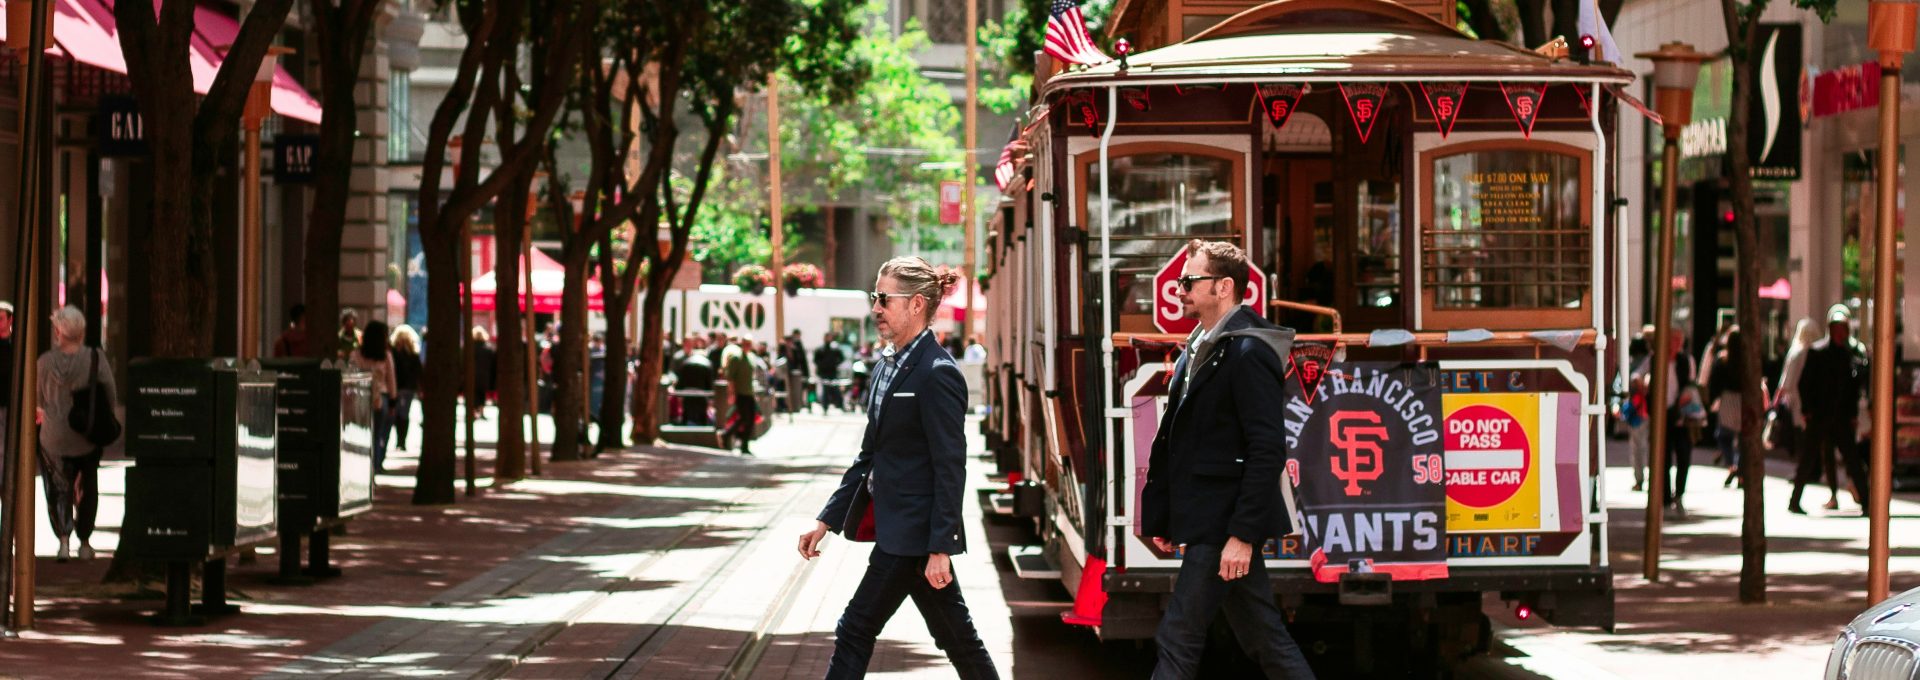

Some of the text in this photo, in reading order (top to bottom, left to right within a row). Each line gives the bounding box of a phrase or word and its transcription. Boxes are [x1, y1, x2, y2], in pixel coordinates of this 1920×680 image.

[286, 145, 312, 164] GAP
[1530, 173, 1549, 183] WAY
[1748, 167, 1797, 177] EPHORA
[1161, 280, 1259, 321] SP
[700, 300, 766, 330] GSO
[1440, 371, 1493, 391] EET
[1317, 366, 1439, 446] FRANCISCO
[1450, 419, 1511, 434] DO NOT
[1460, 434, 1502, 449] PASS
[1285, 458, 1300, 488] 9
[1411, 454, 1443, 484] 58
[1445, 471, 1521, 485] CABLE CAR
[1445, 535, 1541, 556] HARF
